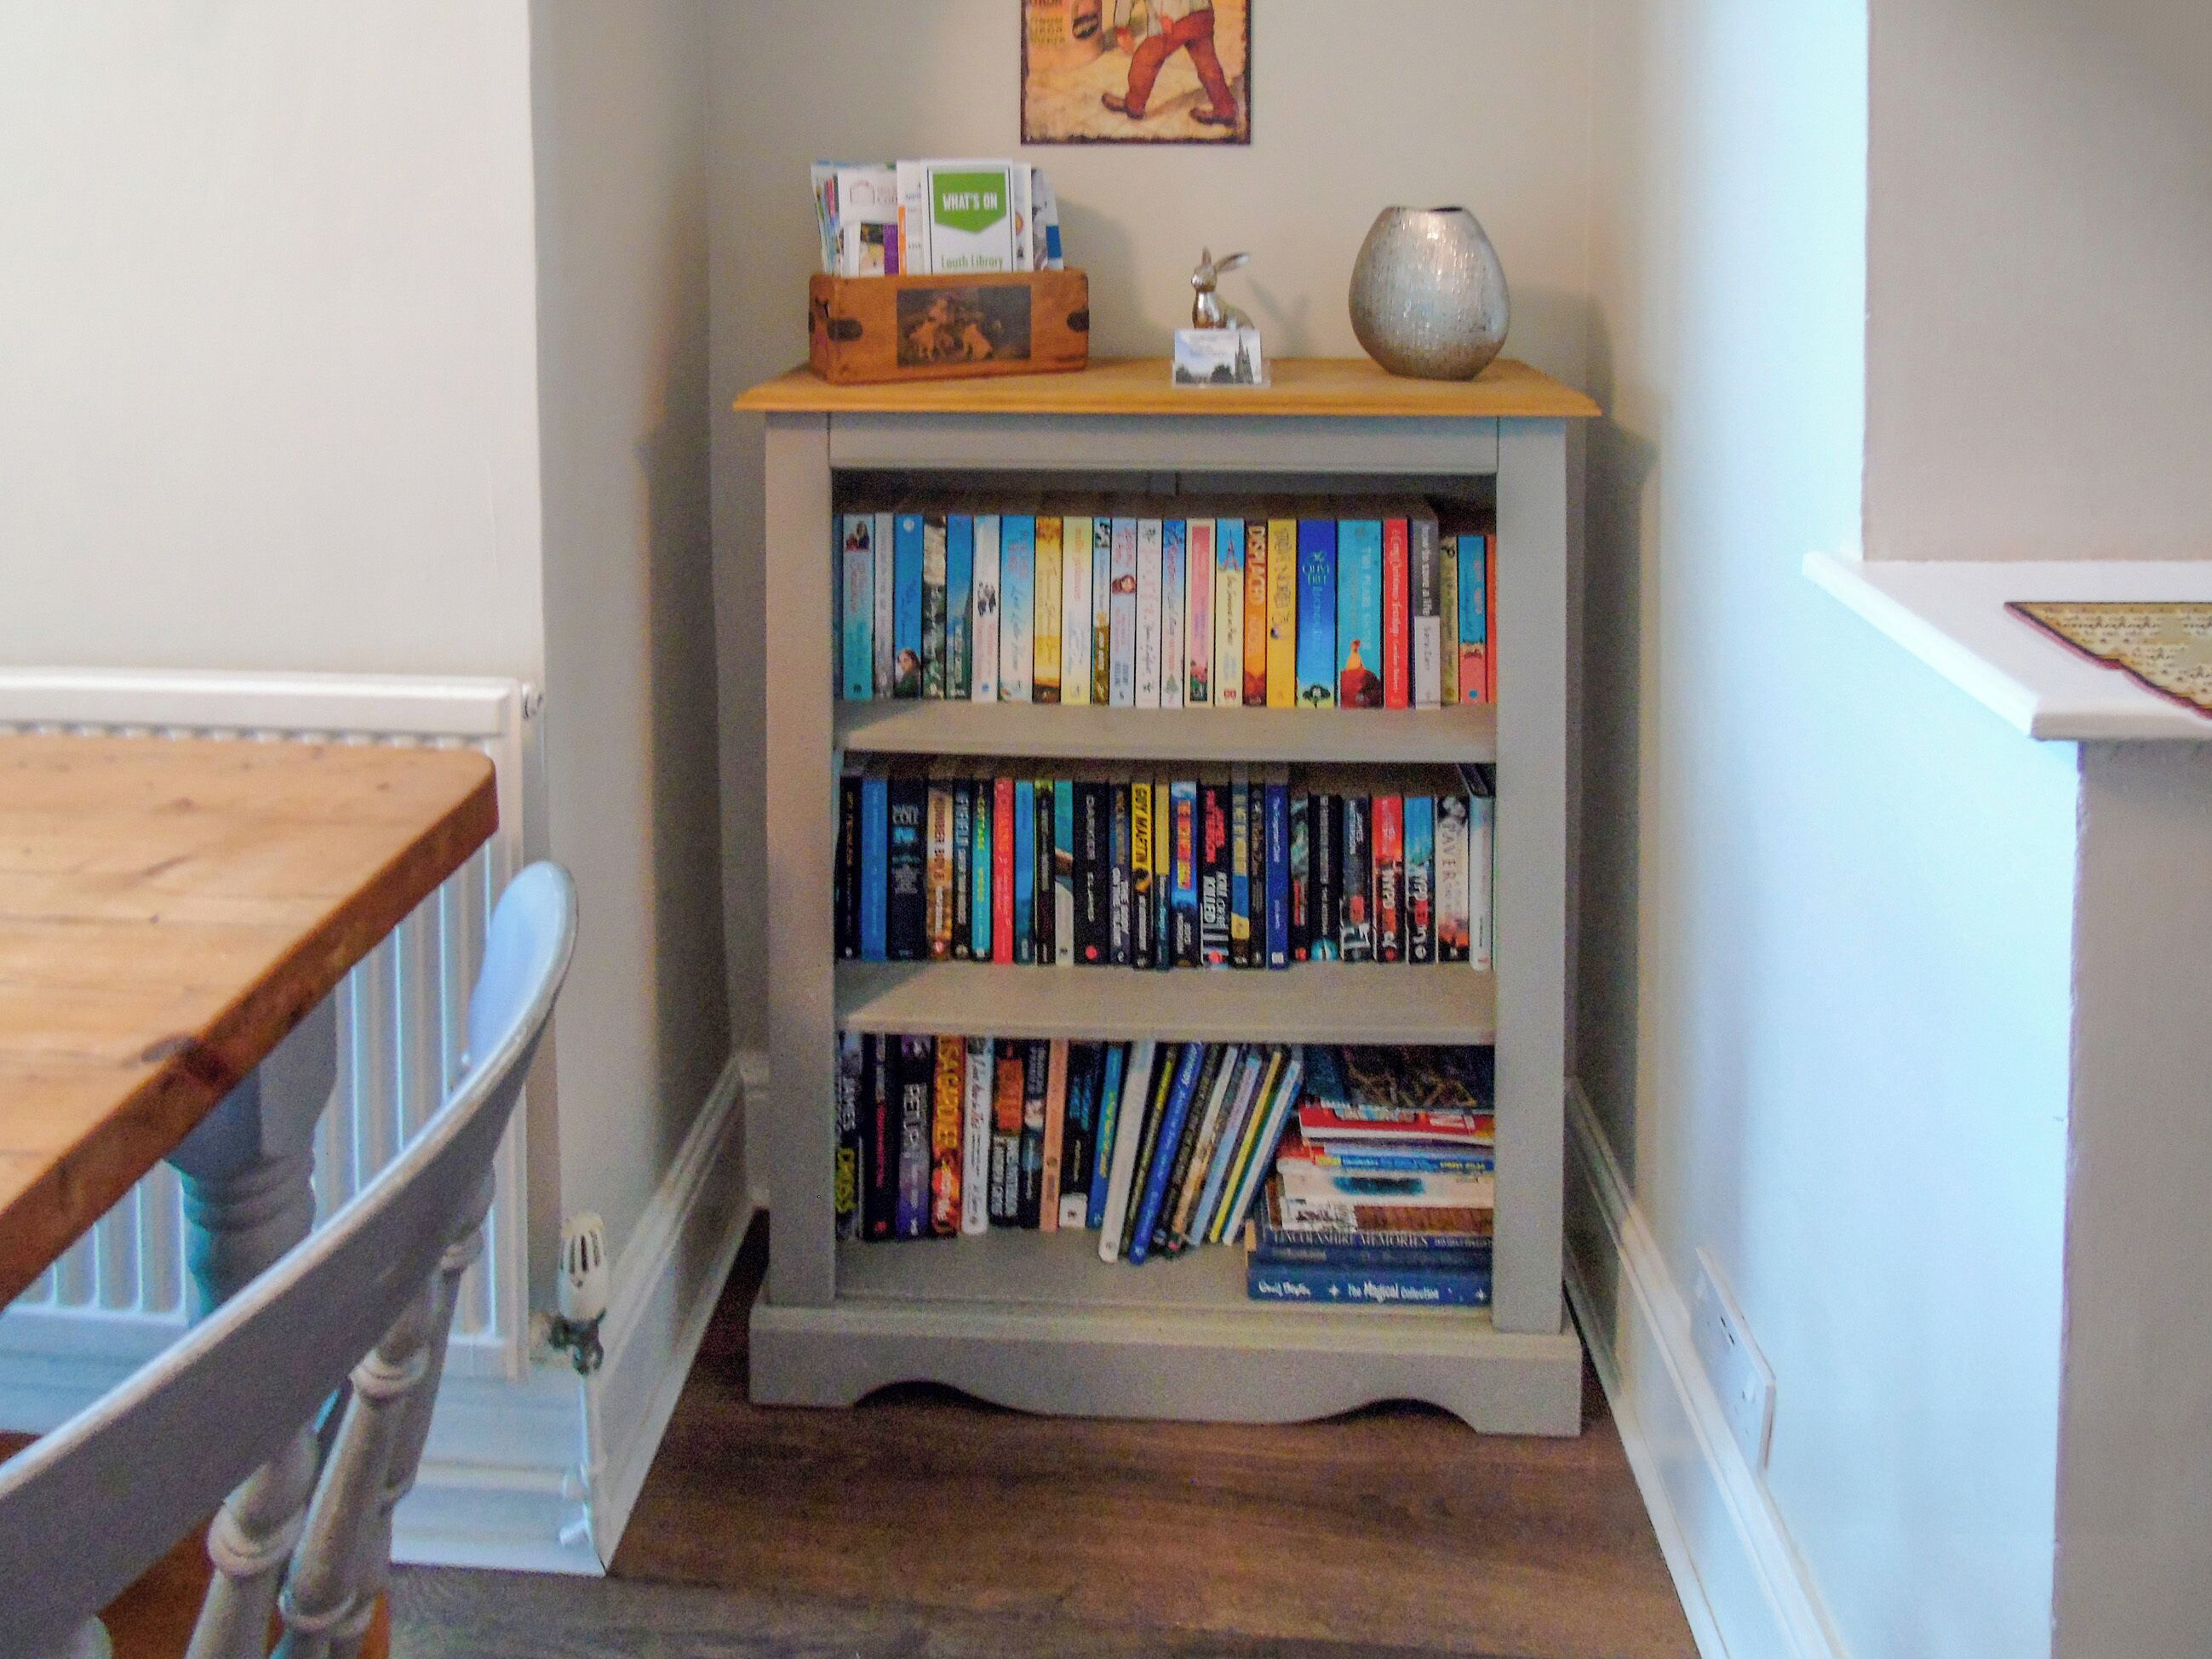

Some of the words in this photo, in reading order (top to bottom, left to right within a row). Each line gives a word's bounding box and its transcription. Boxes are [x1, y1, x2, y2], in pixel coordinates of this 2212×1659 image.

[943, 193, 979, 211] WHAT'S
[983, 193, 997, 209] ON
[942, 256, 967, 269] Louth
[971, 255, 1004, 272] Library
[1422, 523, 1430, 546] how
[1248, 526, 1265, 605] DISPLACED
[1422, 548, 1430, 562] to
[1422, 598, 1432, 616] life
[1136, 787, 1147, 813] GUY
[1086, 794, 1095, 861] DARKER
[1135, 815, 1147, 864] MARTIN
[1206, 790, 1216, 864] PATTERSON
[1217, 872, 1227, 896] KILL
[1383, 869, 1394, 909] NYPD
[1203, 876, 1216, 924] KILLED
[843, 1077, 856, 1131] JAMES
[1360, 1233, 1429, 1248] MEMORIES
[1347, 1283, 1362, 1296] The
[1364, 1280, 1399, 1303] Magical
